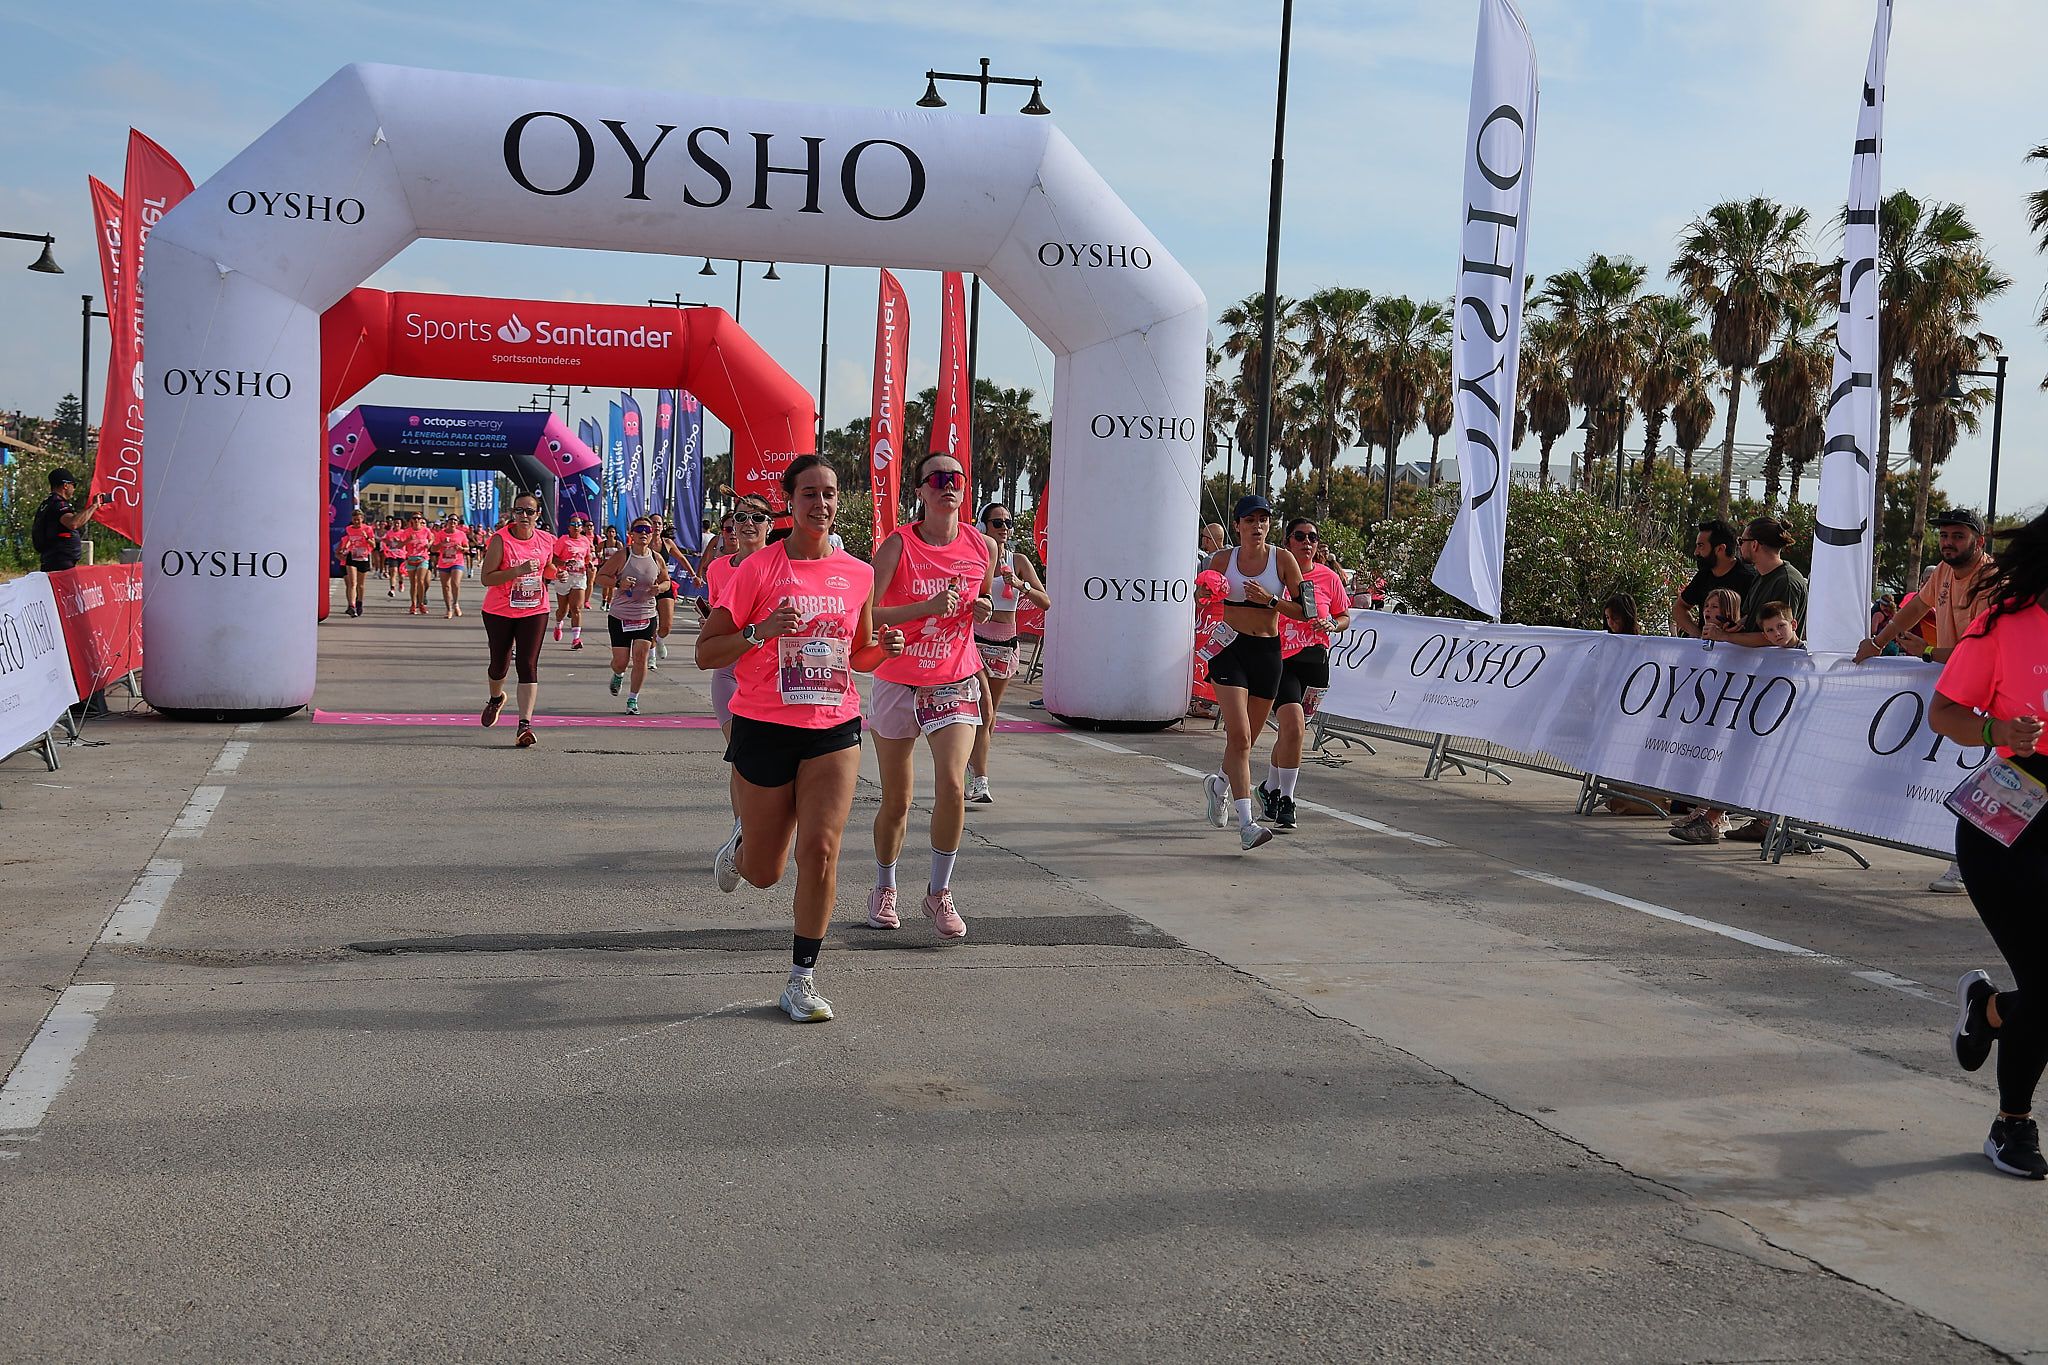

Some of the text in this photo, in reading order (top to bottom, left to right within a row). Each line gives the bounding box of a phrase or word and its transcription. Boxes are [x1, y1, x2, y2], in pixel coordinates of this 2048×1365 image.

[503, 111, 926, 221] OYSHO
[228, 191, 364, 224] OYSHO
[1038, 243, 1151, 269] OYSHO
[405, 313, 672, 348] Sports Santander
[492, 353, 581, 366] sportssantander.es
[164, 369, 290, 399] OYSHO
[423, 416, 503, 431] octopus energy
[1091, 415, 1194, 441] OYSHO
[421, 440, 466, 448] VELOCIDAD
[161, 550, 287, 578] OYSHO
[1084, 577, 1187, 602] OYSHO
[905, 641, 953, 660] MUJER
[1410, 634, 1547, 689] OYSHO
[804, 667, 832, 679] 016
[936, 700, 960, 712] 016
[1620, 661, 1797, 736] OYSHO
[1645, 737, 1723, 762] WWW.OYSHO.COM
[1971, 789, 2002, 815] 016
